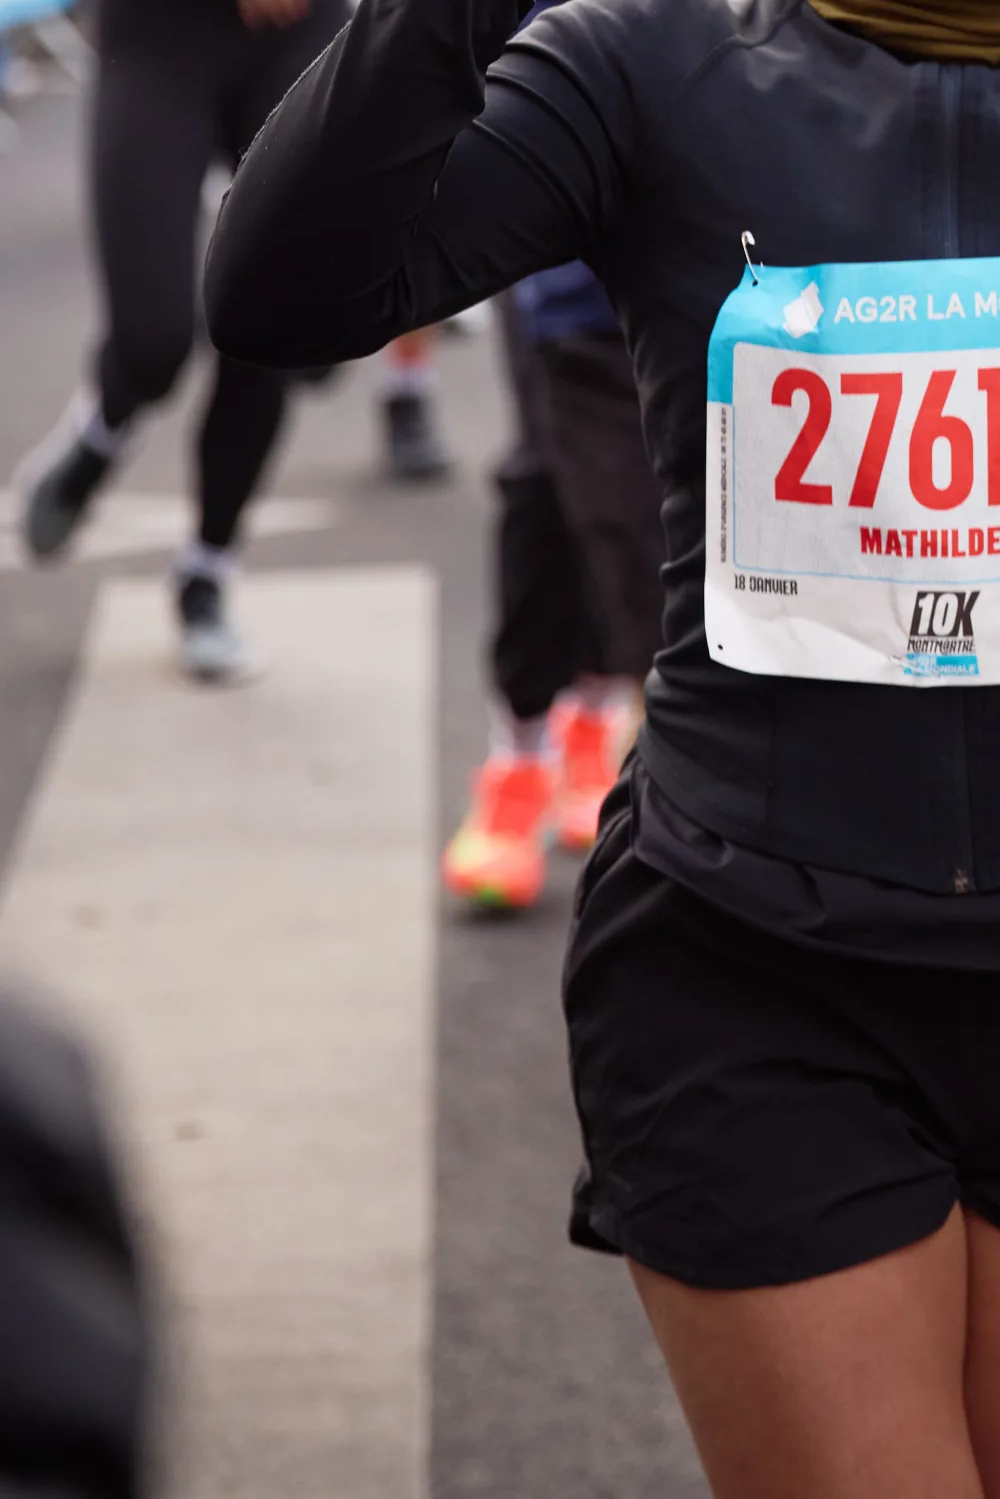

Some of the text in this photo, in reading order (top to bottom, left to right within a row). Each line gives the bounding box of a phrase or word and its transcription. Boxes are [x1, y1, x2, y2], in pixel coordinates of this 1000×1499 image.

[834, 294, 917, 324] AG2R
[927, 292, 966, 321] LA
[860, 525, 1000, 558] MATHILDE
[734, 573, 798, 596] 18 JANVIER
[909, 590, 981, 637] 10K
